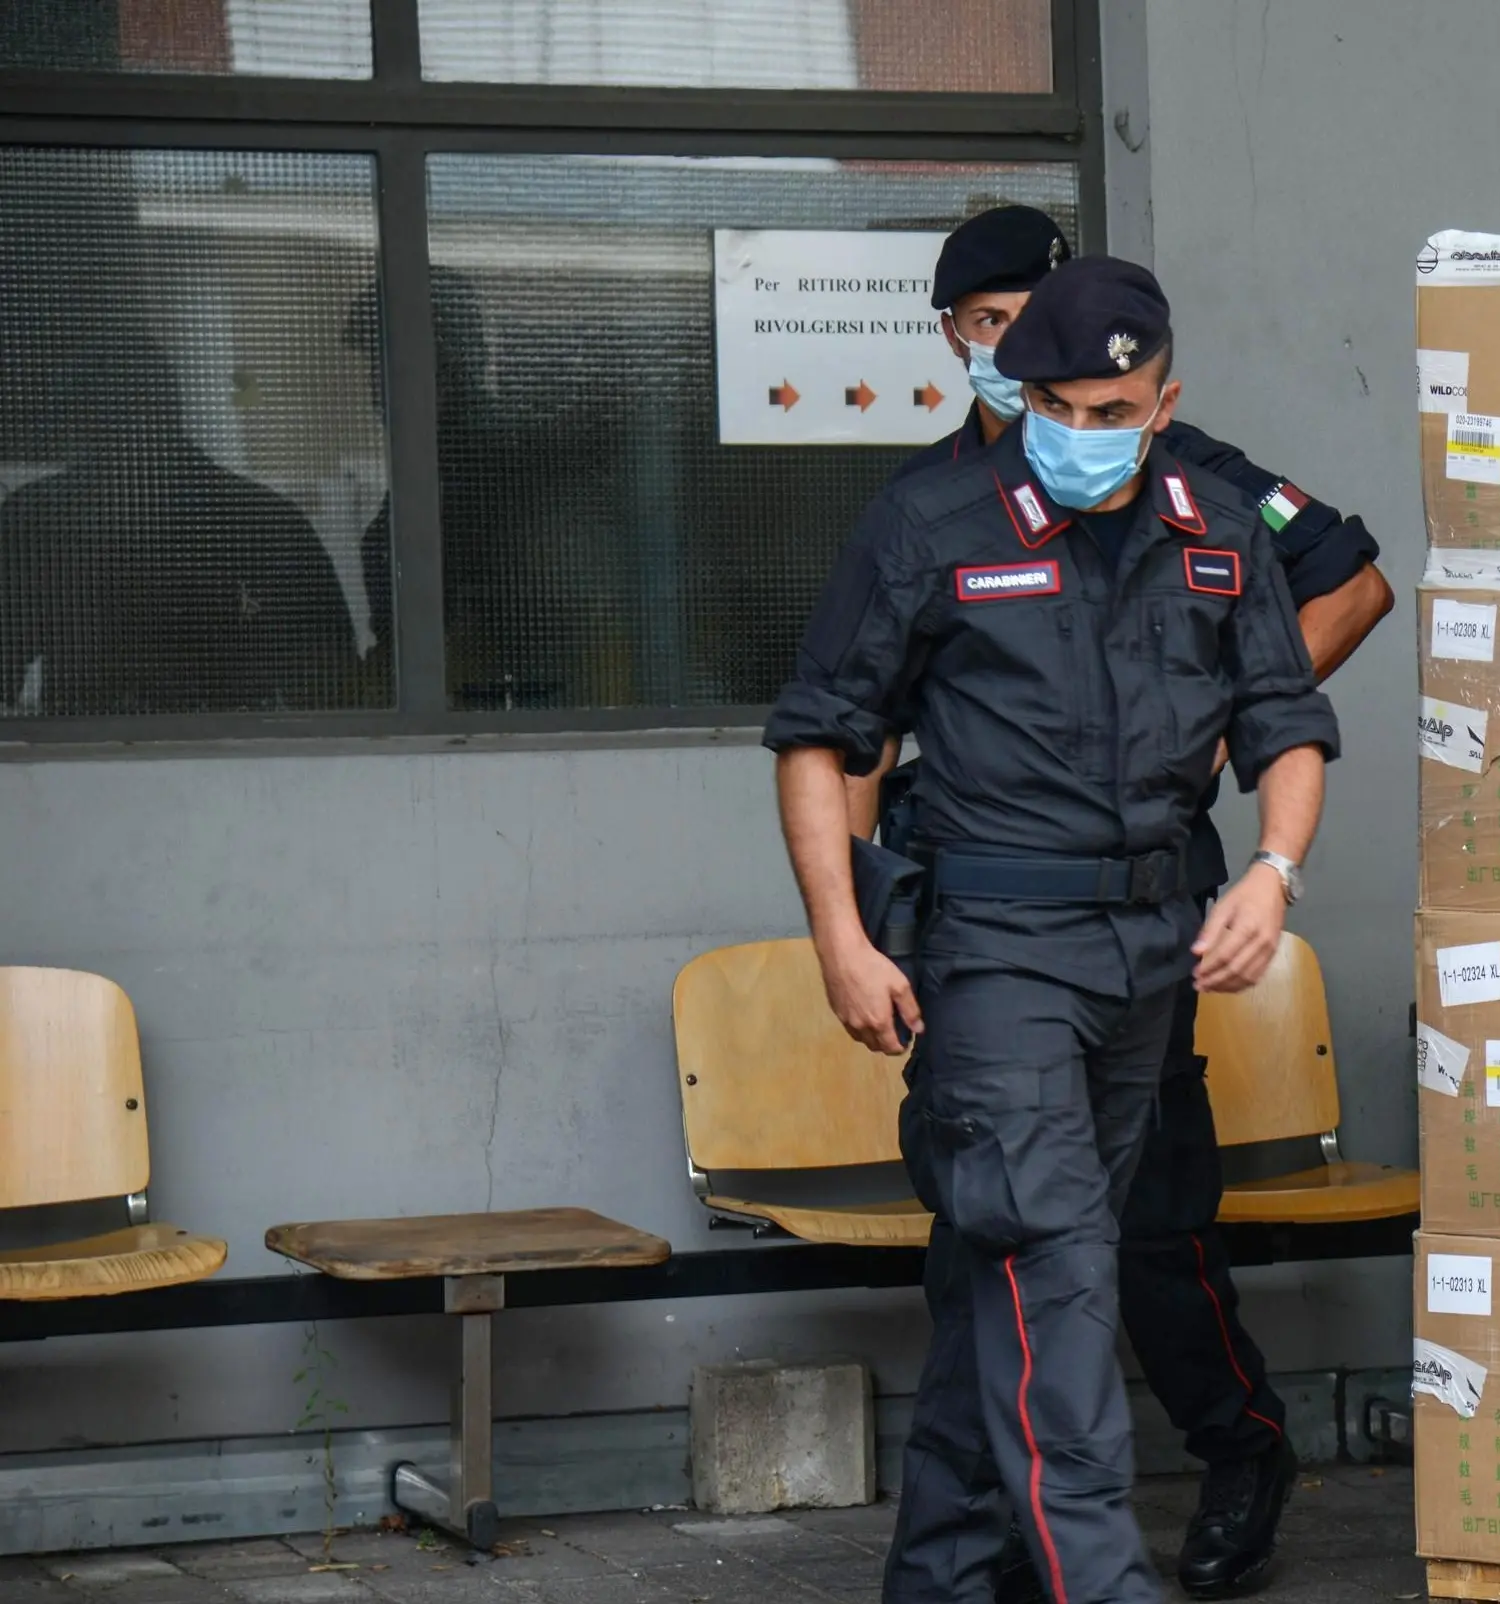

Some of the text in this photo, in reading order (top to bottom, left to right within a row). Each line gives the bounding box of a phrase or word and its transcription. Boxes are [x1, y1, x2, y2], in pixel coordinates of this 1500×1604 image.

[755, 277, 931, 293] Per RITIRO RICETT
[755, 319, 864, 334] RIVOLGERSI
[870, 320, 887, 334] IN
[1257, 482, 1284, 509] ITALIA
[967, 572, 1047, 589] CARABINIERI
[1436, 621, 1491, 639] 1-1-02308 XL
[1443, 963, 1500, 984] 1-1-02324 XL
[1432, 1277, 1487, 1293] 1-1-02313 XL
